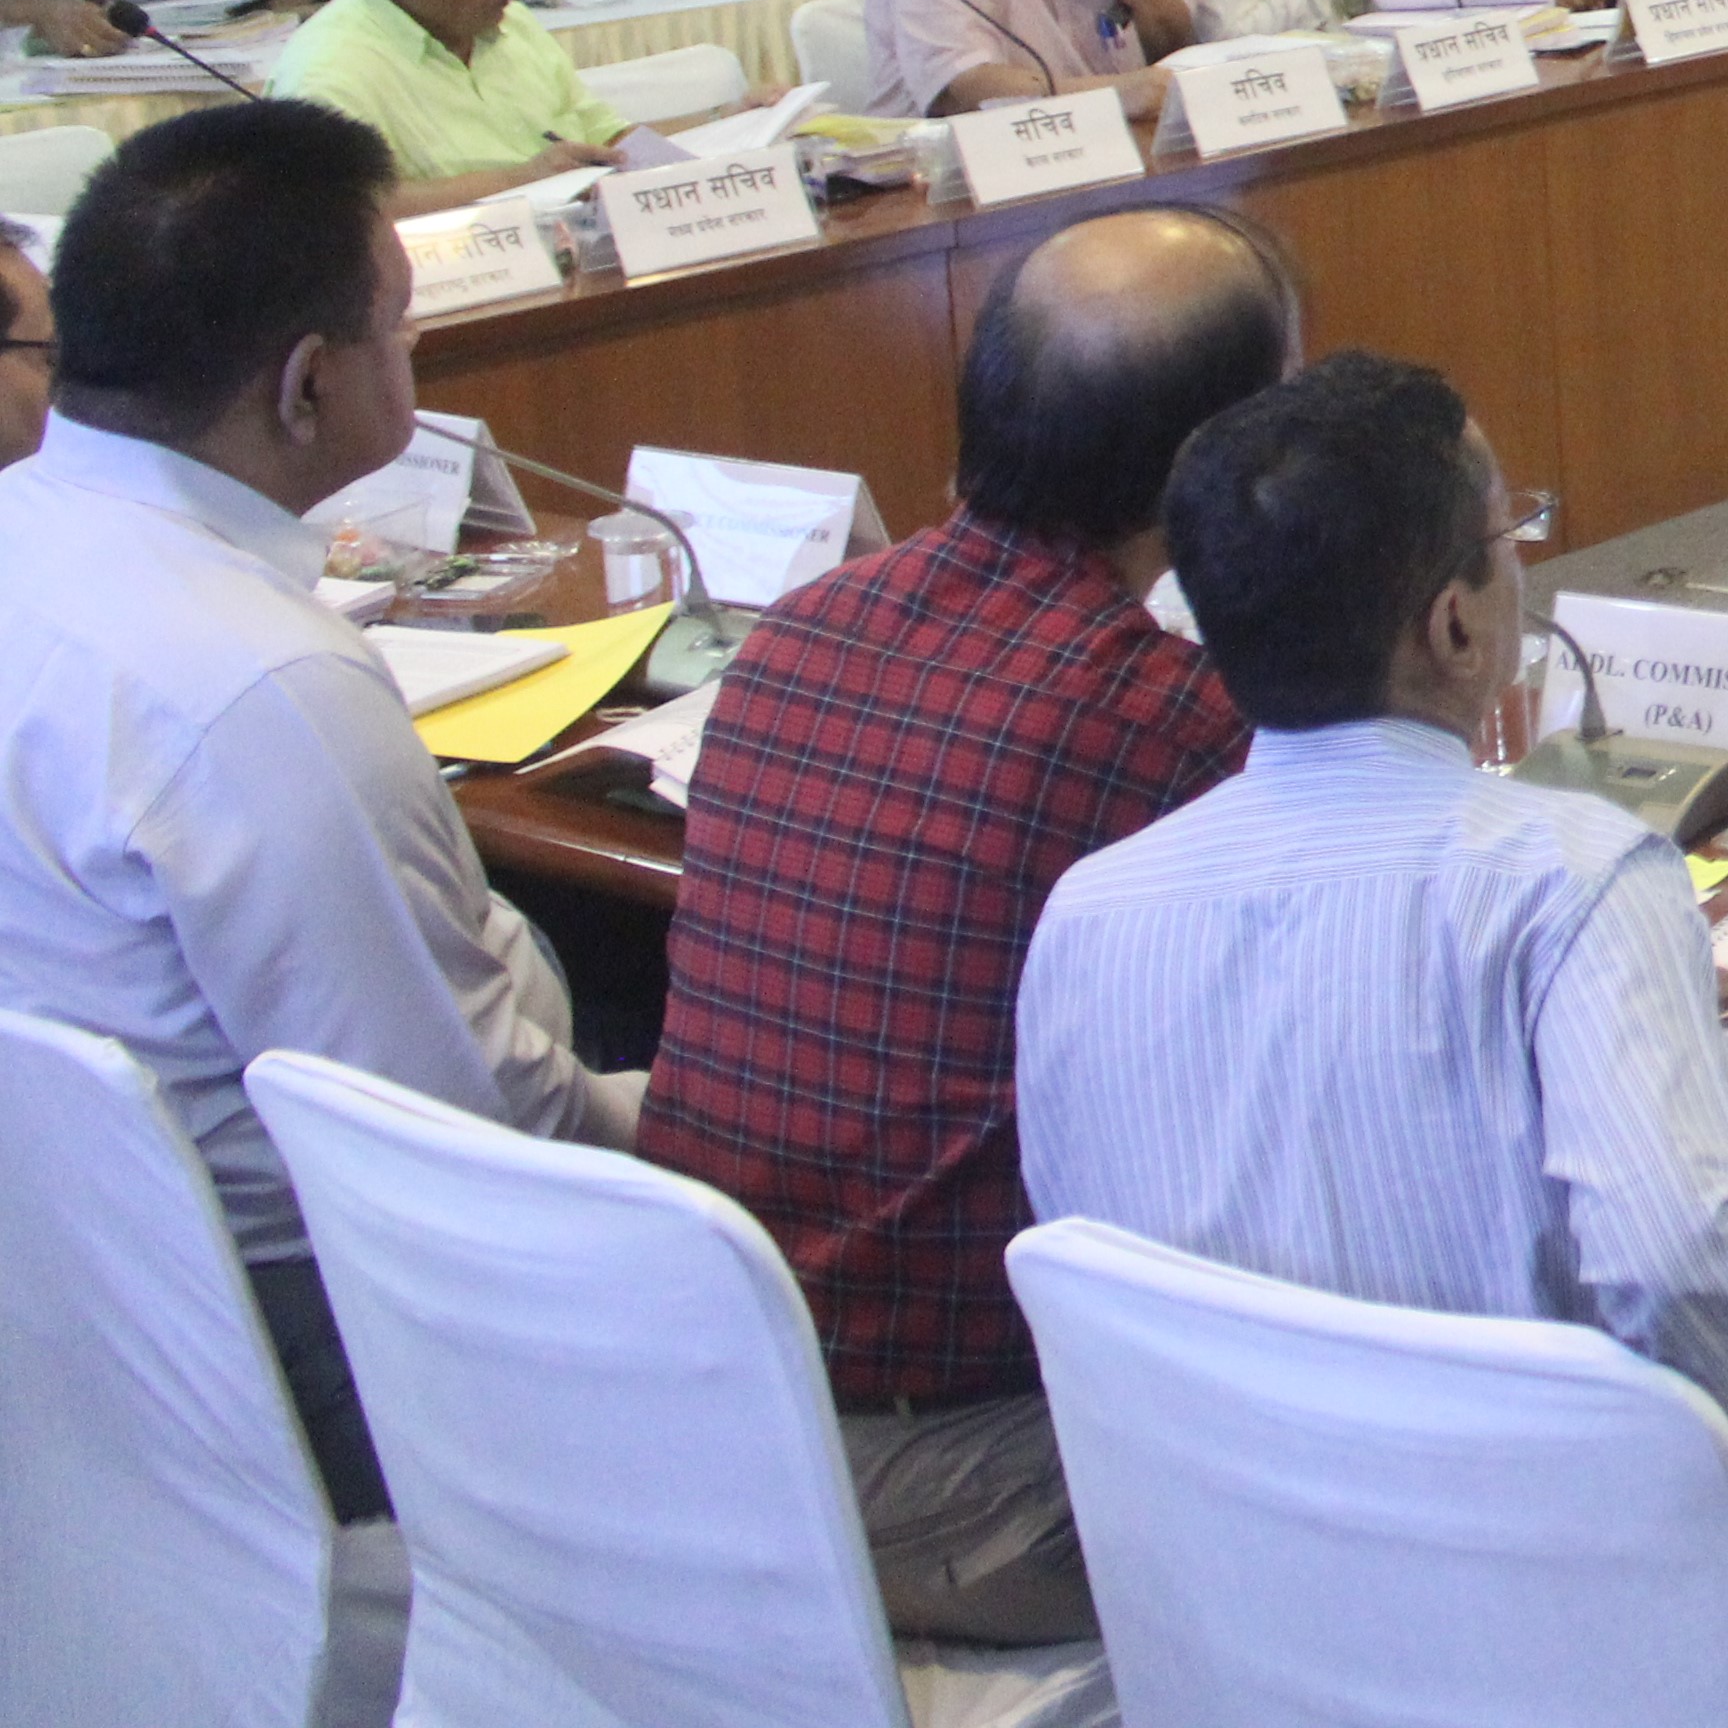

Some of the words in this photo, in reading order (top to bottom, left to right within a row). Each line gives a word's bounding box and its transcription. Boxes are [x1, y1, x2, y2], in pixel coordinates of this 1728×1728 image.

[1414, 35, 1462, 63] प्रधान
[1462, 20, 1511, 49] सचिव
[1230, 68, 1288, 101] सचिव
[1010, 108, 1076, 142] सचिव
[632, 180, 702, 214] प्रधान
[706, 162, 777, 200] सचिव
[1644, 703, 1713, 734] (P&A)
